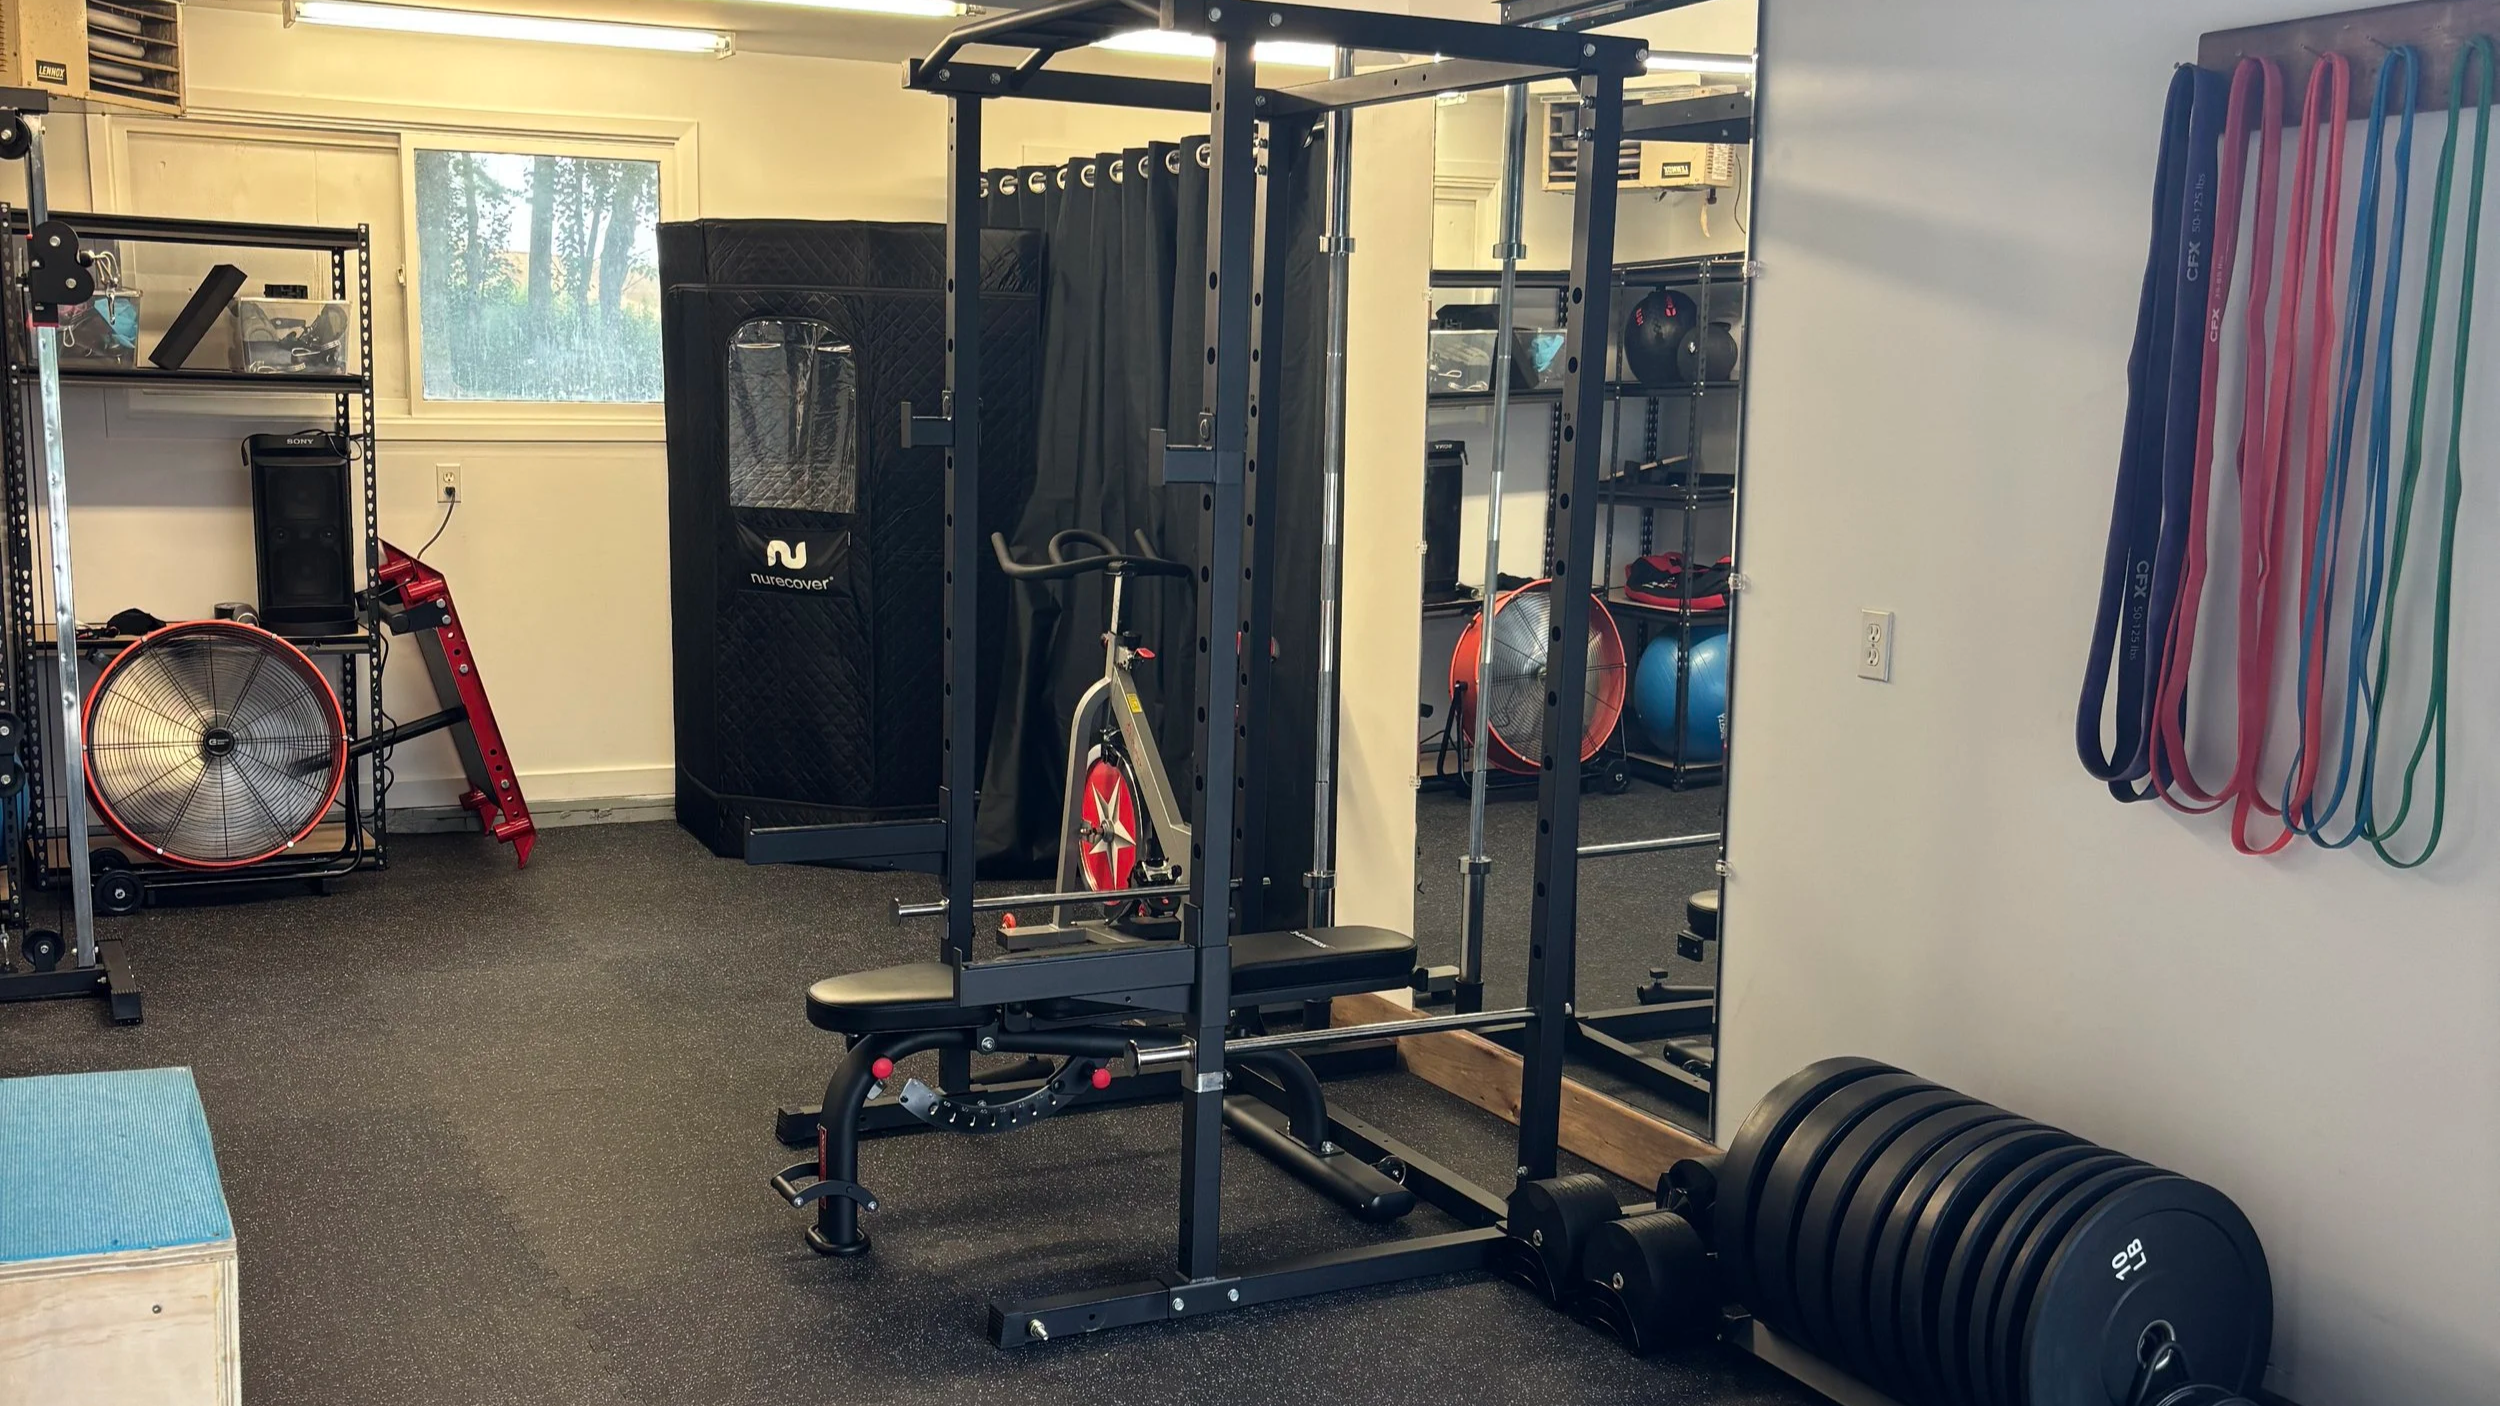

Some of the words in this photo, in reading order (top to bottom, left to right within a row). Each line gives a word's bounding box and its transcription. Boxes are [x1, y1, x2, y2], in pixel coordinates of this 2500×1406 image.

[38, 65, 65, 79] LENNOX
[2195, 173, 2206, 189] lbs
[2192, 192, 2204, 233] 50-125
[2186, 241, 2200, 281] CFX
[2210, 308, 2220, 343] CFX
[750, 573, 830, 590] nurecover
[2133, 560, 2149, 598] CFX
[2131, 606, 2143, 643] 50-125
[2129, 645, 2140, 661] lbs
[2111, 1251, 2131, 1281] 10
[2126, 1238, 2147, 1272] LB
